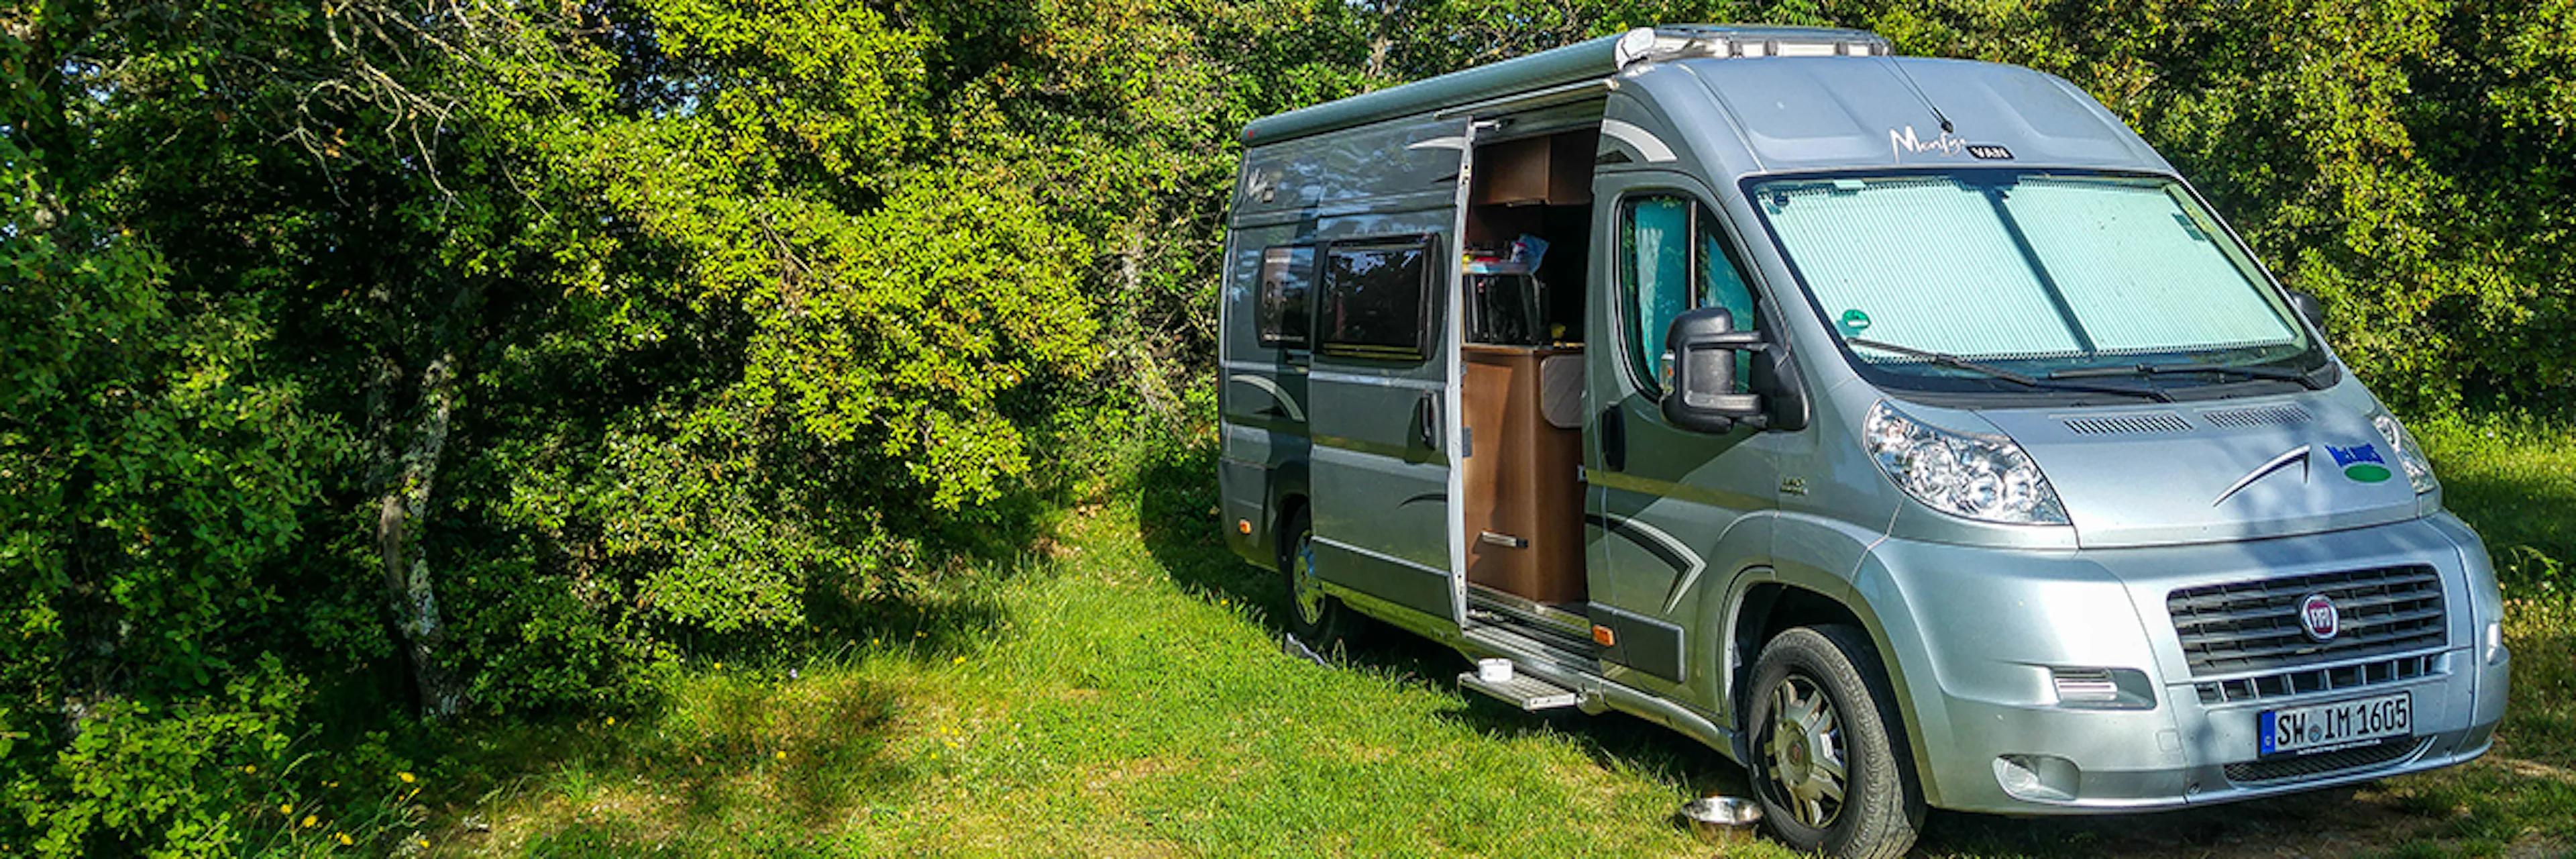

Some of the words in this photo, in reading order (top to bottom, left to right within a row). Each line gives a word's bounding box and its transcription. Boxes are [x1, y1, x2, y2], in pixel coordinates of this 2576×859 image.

[1971, 146, 2011, 159] VAN
[2324, 707, 2351, 739] IM
[2357, 699, 2407, 735] 1605
